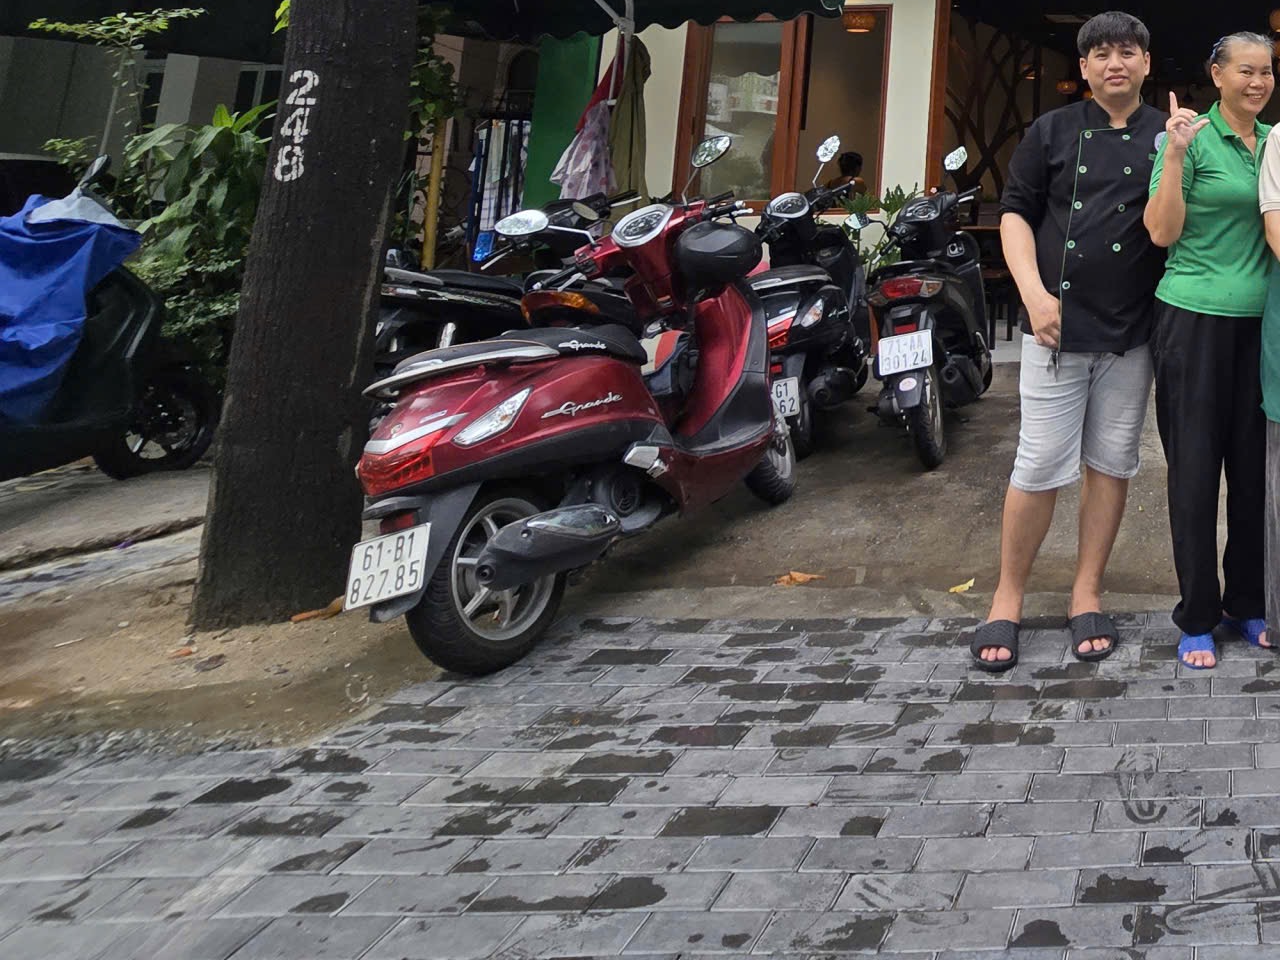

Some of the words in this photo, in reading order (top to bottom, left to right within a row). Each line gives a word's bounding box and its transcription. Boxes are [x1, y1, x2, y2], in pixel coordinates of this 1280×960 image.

[775, 382, 788, 399] G1
[541, 392, 623, 419] Grande
[780, 396, 796, 414] 62
[362, 531, 415, 572] 61-B1
[349, 559, 420, 605] 827.85
